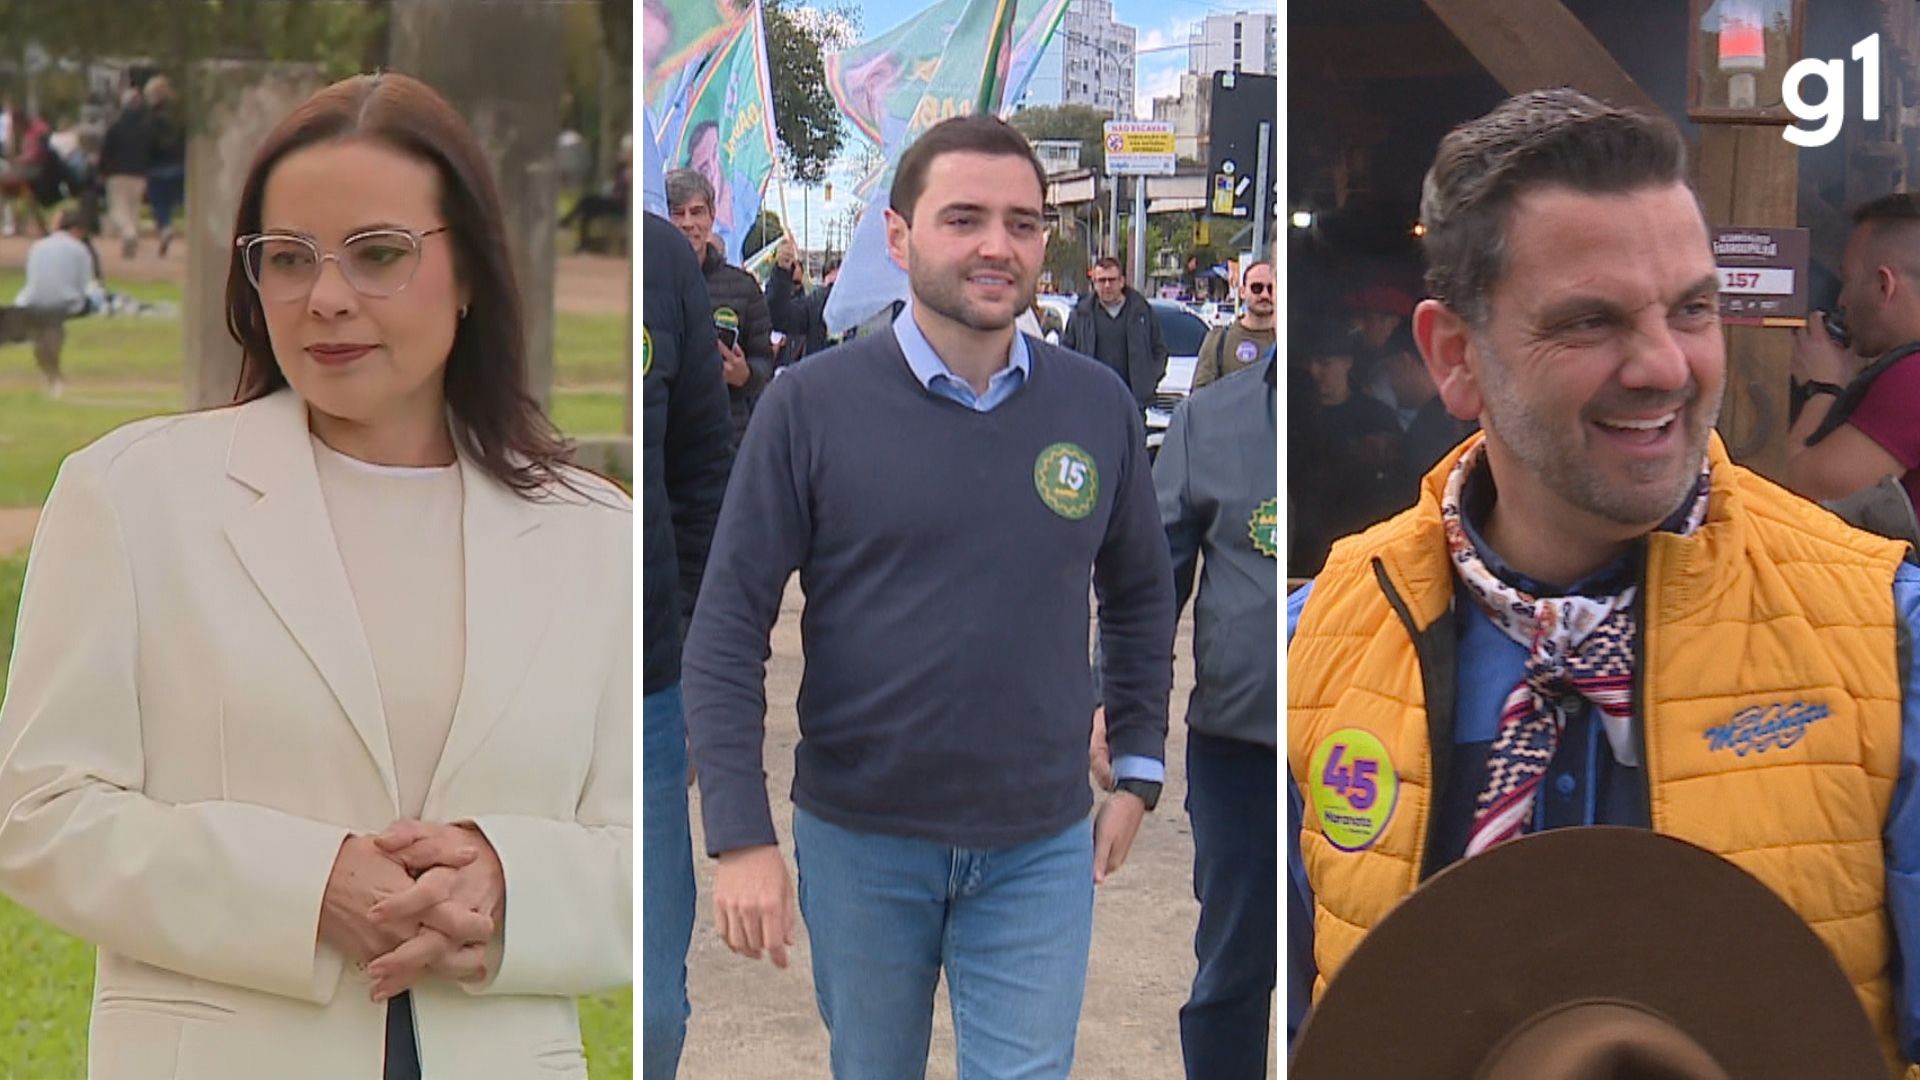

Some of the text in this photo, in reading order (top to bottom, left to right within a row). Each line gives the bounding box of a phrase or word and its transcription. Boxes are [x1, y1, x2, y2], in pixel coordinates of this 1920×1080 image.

[1725, 272, 1760, 288] 157
[1059, 455, 1087, 491] 15
[1322, 744, 1379, 811] 45
